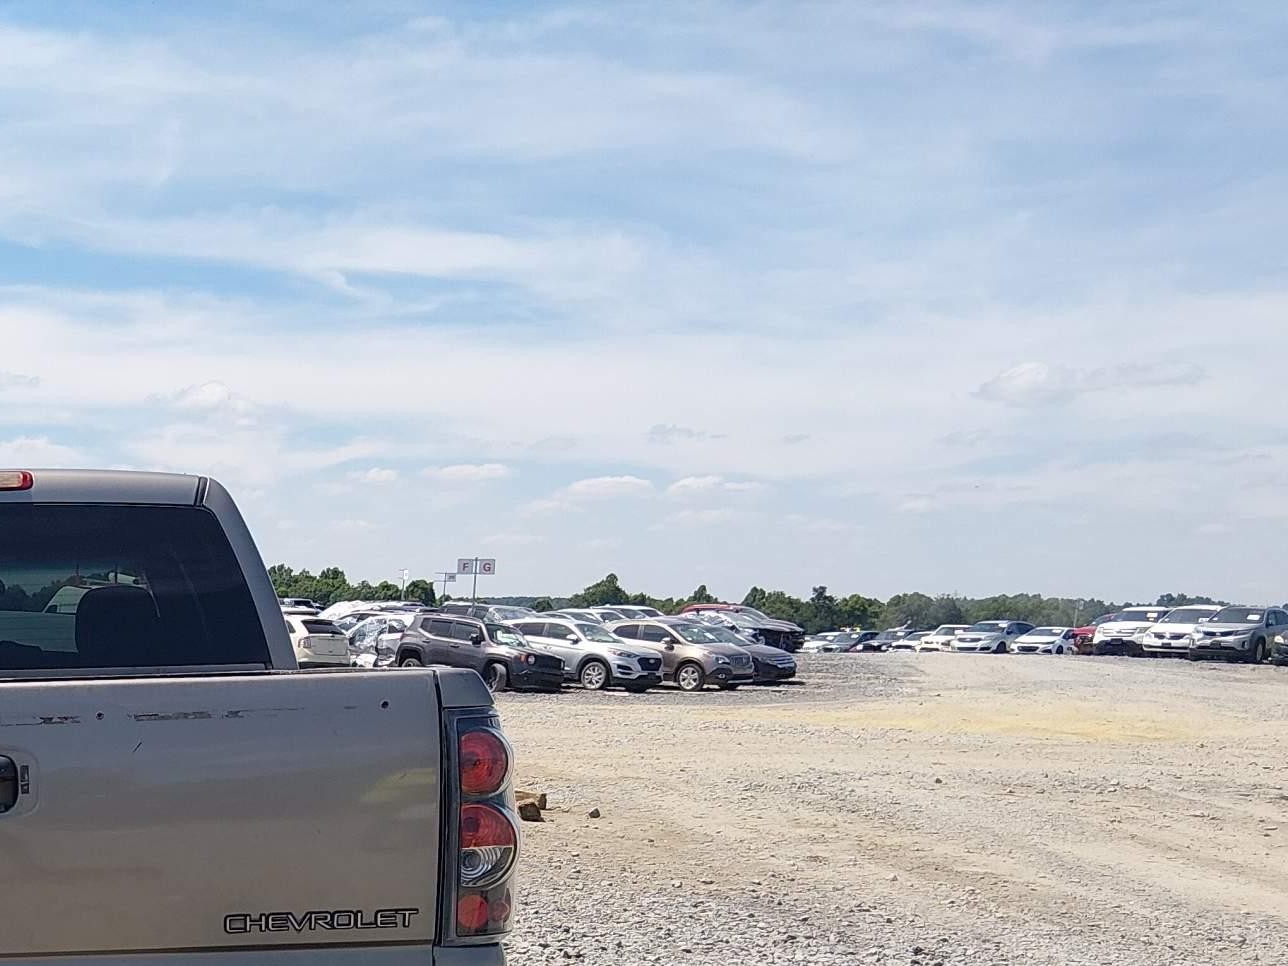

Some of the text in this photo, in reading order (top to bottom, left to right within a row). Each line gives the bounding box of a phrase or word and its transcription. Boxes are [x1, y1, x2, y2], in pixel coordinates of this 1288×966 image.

[462, 562, 492, 572] F G
[225, 908, 419, 933] CHEVROLET
